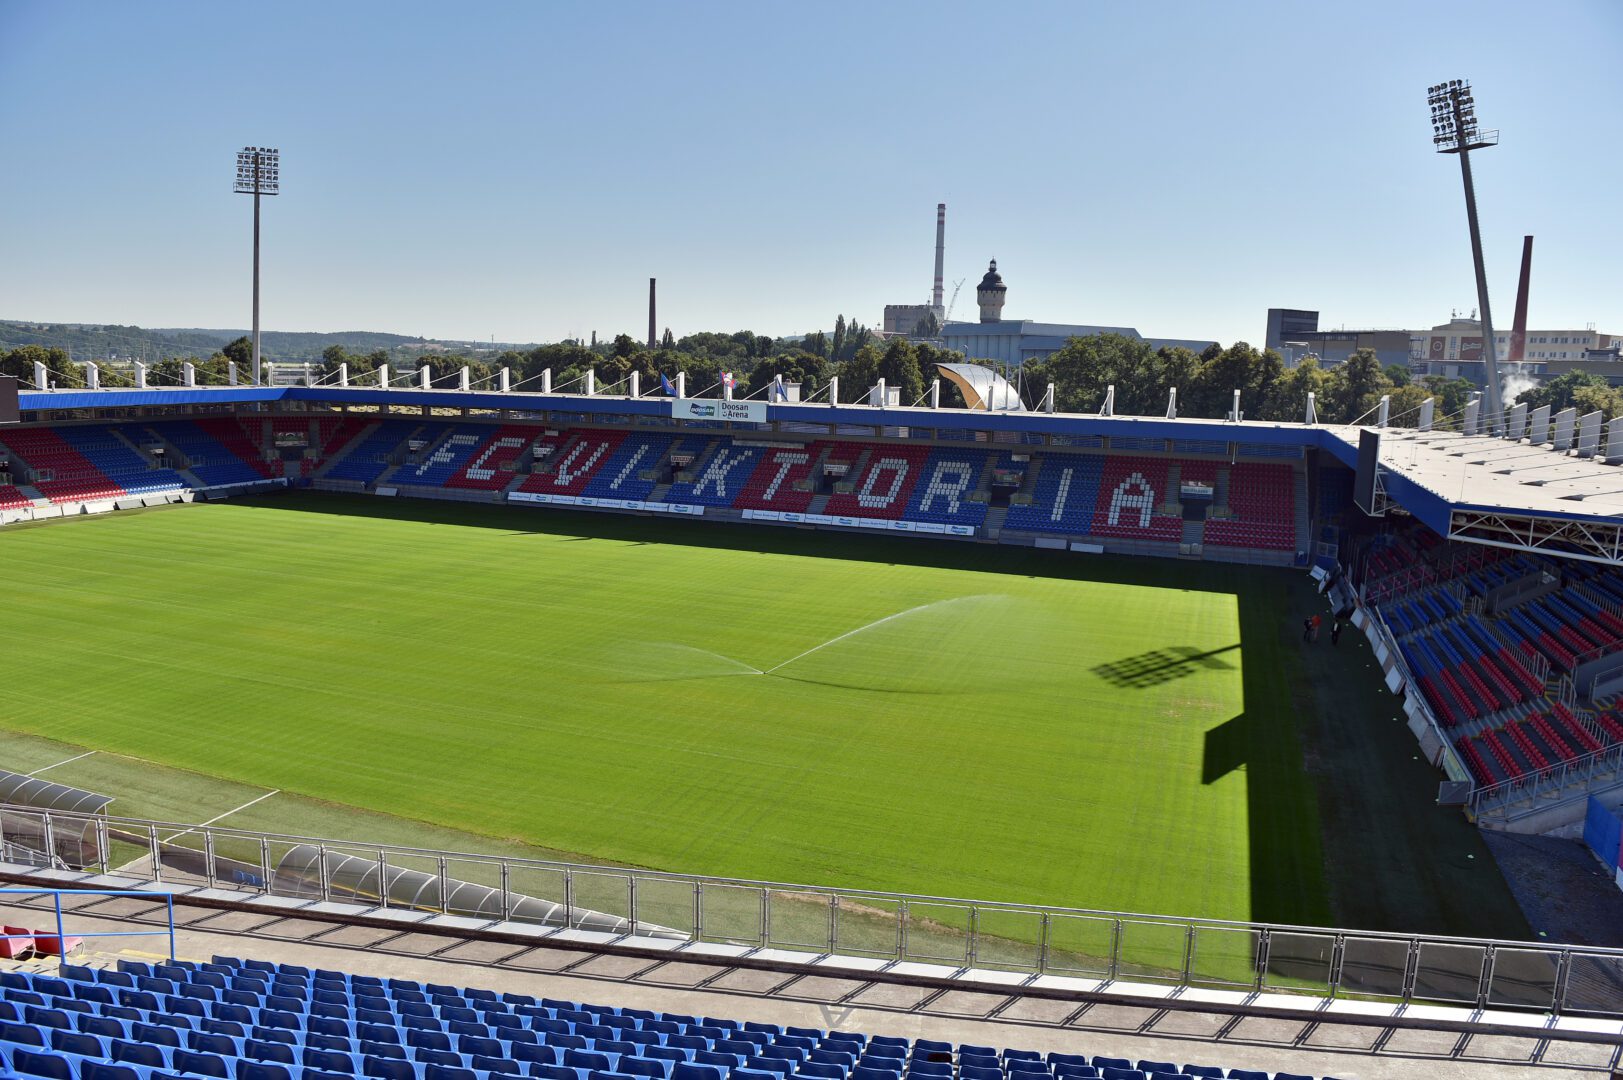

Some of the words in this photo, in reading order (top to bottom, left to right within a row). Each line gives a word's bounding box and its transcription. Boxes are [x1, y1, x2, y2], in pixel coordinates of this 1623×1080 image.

[721, 402, 749, 411] Doosan
[727, 411, 749, 419] Arena
[415, 434, 526, 480] FC
[553, 441, 1155, 528] VIKTORIA
